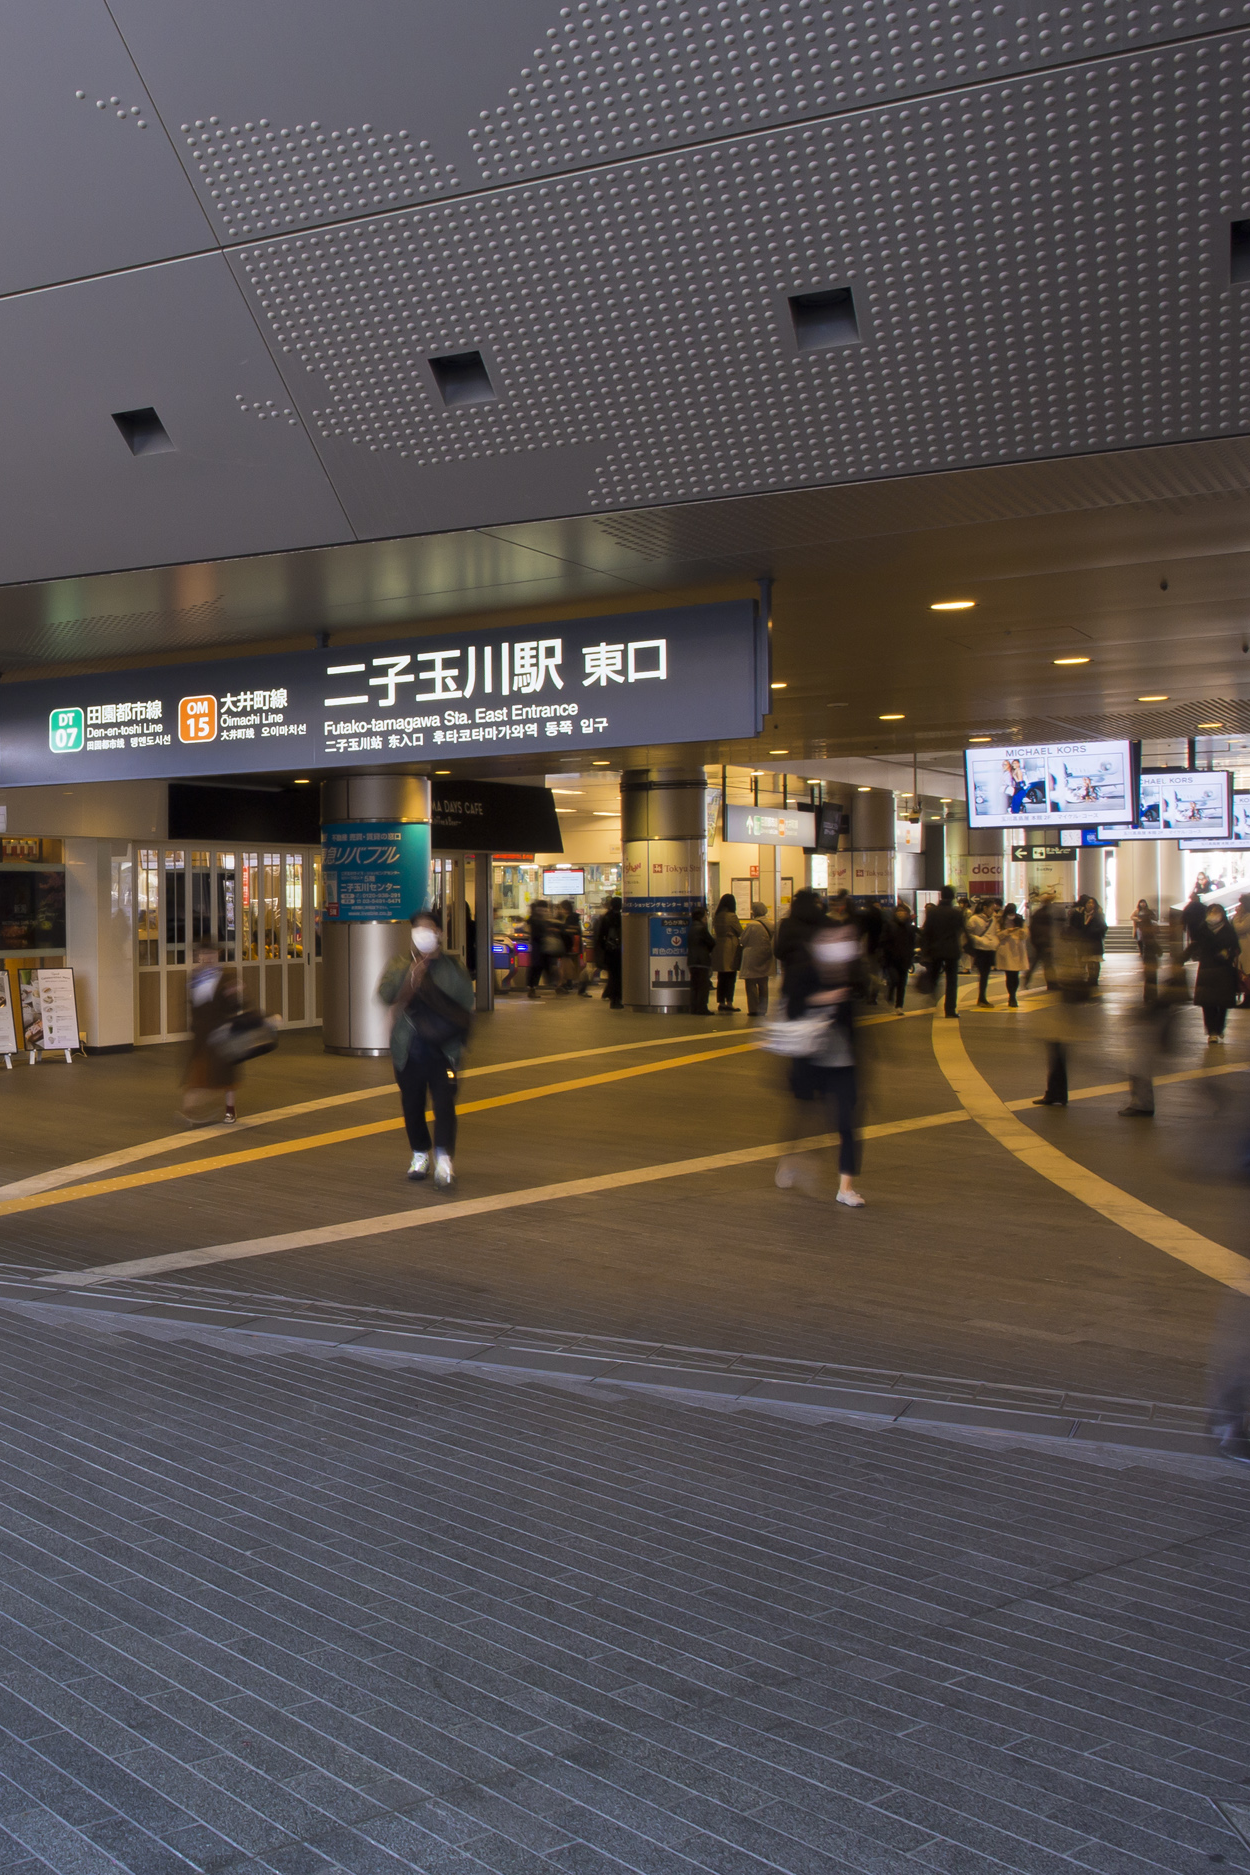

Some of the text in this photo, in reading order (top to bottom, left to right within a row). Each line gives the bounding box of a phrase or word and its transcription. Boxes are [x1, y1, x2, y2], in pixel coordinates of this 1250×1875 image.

[324, 638, 667, 707] 二子玉川駅 東口
[187, 701, 209, 715] OM
[220, 688, 288, 713] 大井町線
[58, 713, 75, 726] DT
[87, 700, 163, 725] 田園都市線
[262, 712, 284, 724] Line
[324, 702, 579, 736] Futako-tamagawa Sta. East Entrance
[87, 721, 163, 739] Den-en-toshi Line
[187, 717, 210, 737] 15
[261, 723, 307, 737] 오이마치선
[432, 717, 609, 745] 후타코타마가와역 동쪽 입구
[55, 728, 78, 748] 07
[324, 733, 424, 753] 二子玉川站 东入口
[1005, 745, 1087, 757] MICHAEL KORS
[1169, 776, 1193, 784] KORS
[444, 800, 463, 814] DAYS
[464, 802, 484, 815] CAFE
[664, 865, 688, 873] Tokyu
[340, 883, 401, 892] 二子玉川センター
